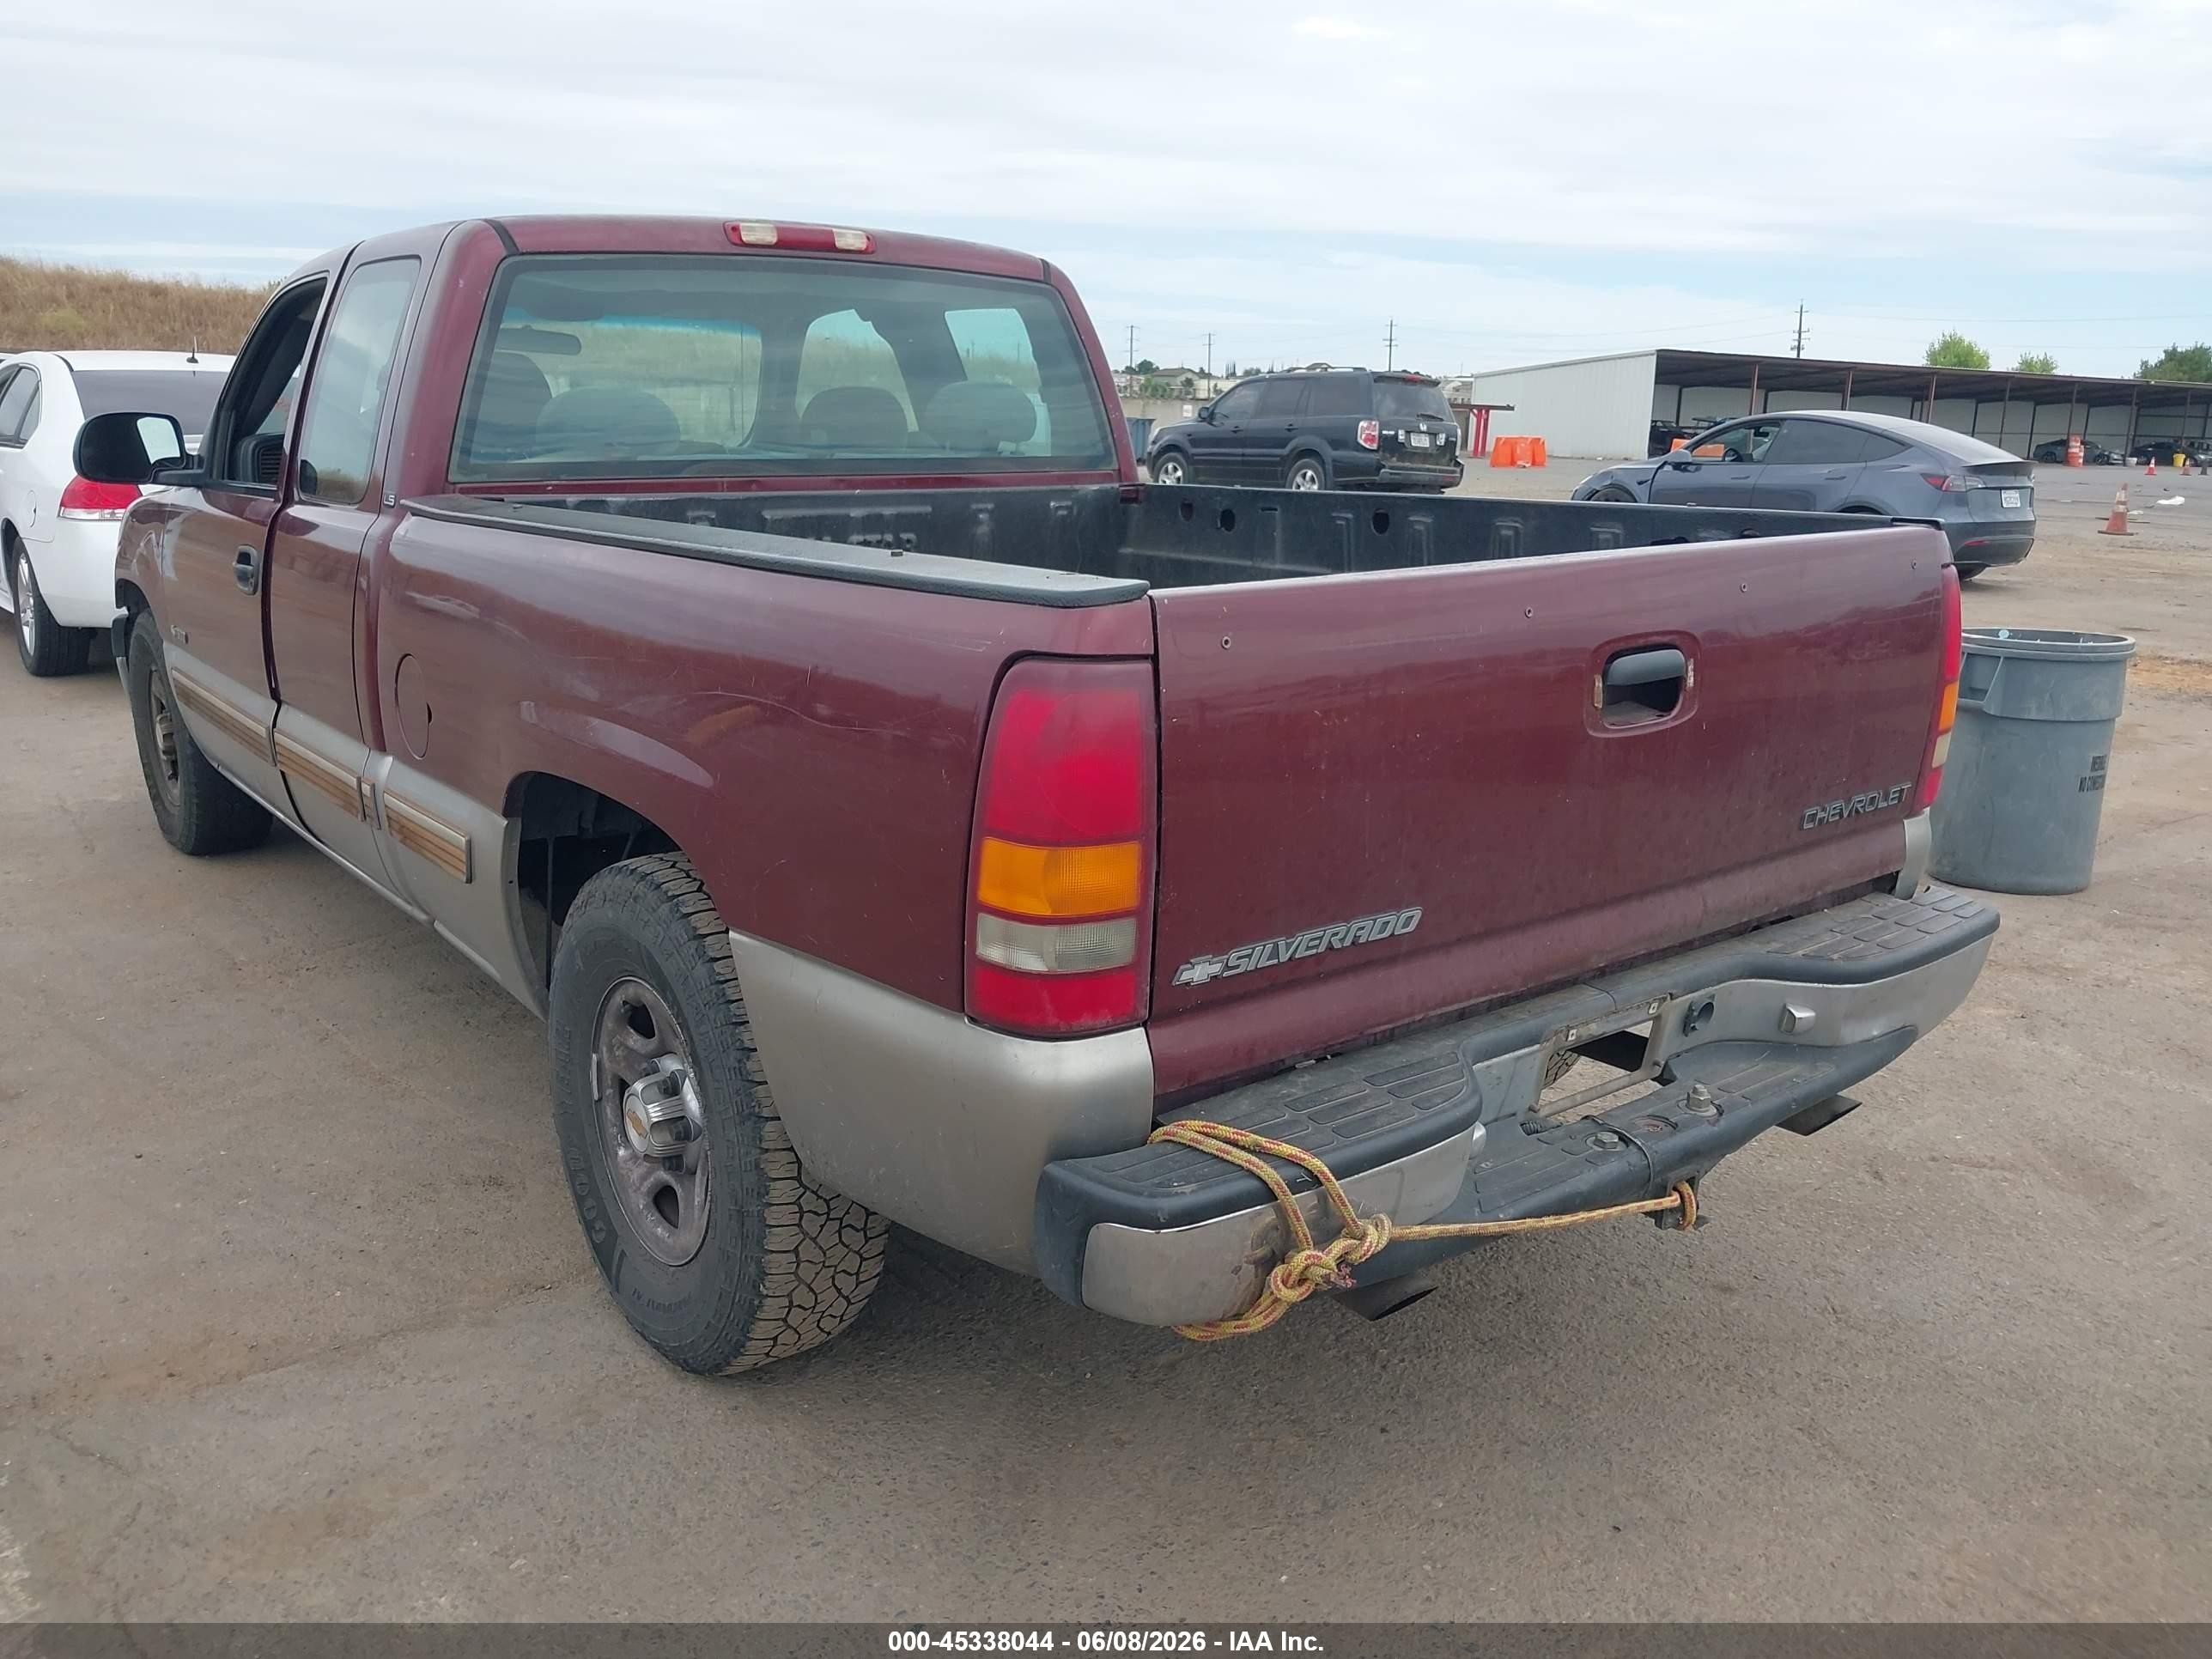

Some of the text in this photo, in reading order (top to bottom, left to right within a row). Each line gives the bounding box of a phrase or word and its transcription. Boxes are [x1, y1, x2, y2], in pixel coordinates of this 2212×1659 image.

[383, 494, 396, 507] LS
[1802, 782, 1912, 830] CHEVROLET
[1222, 908, 1423, 977] SILVERADO
